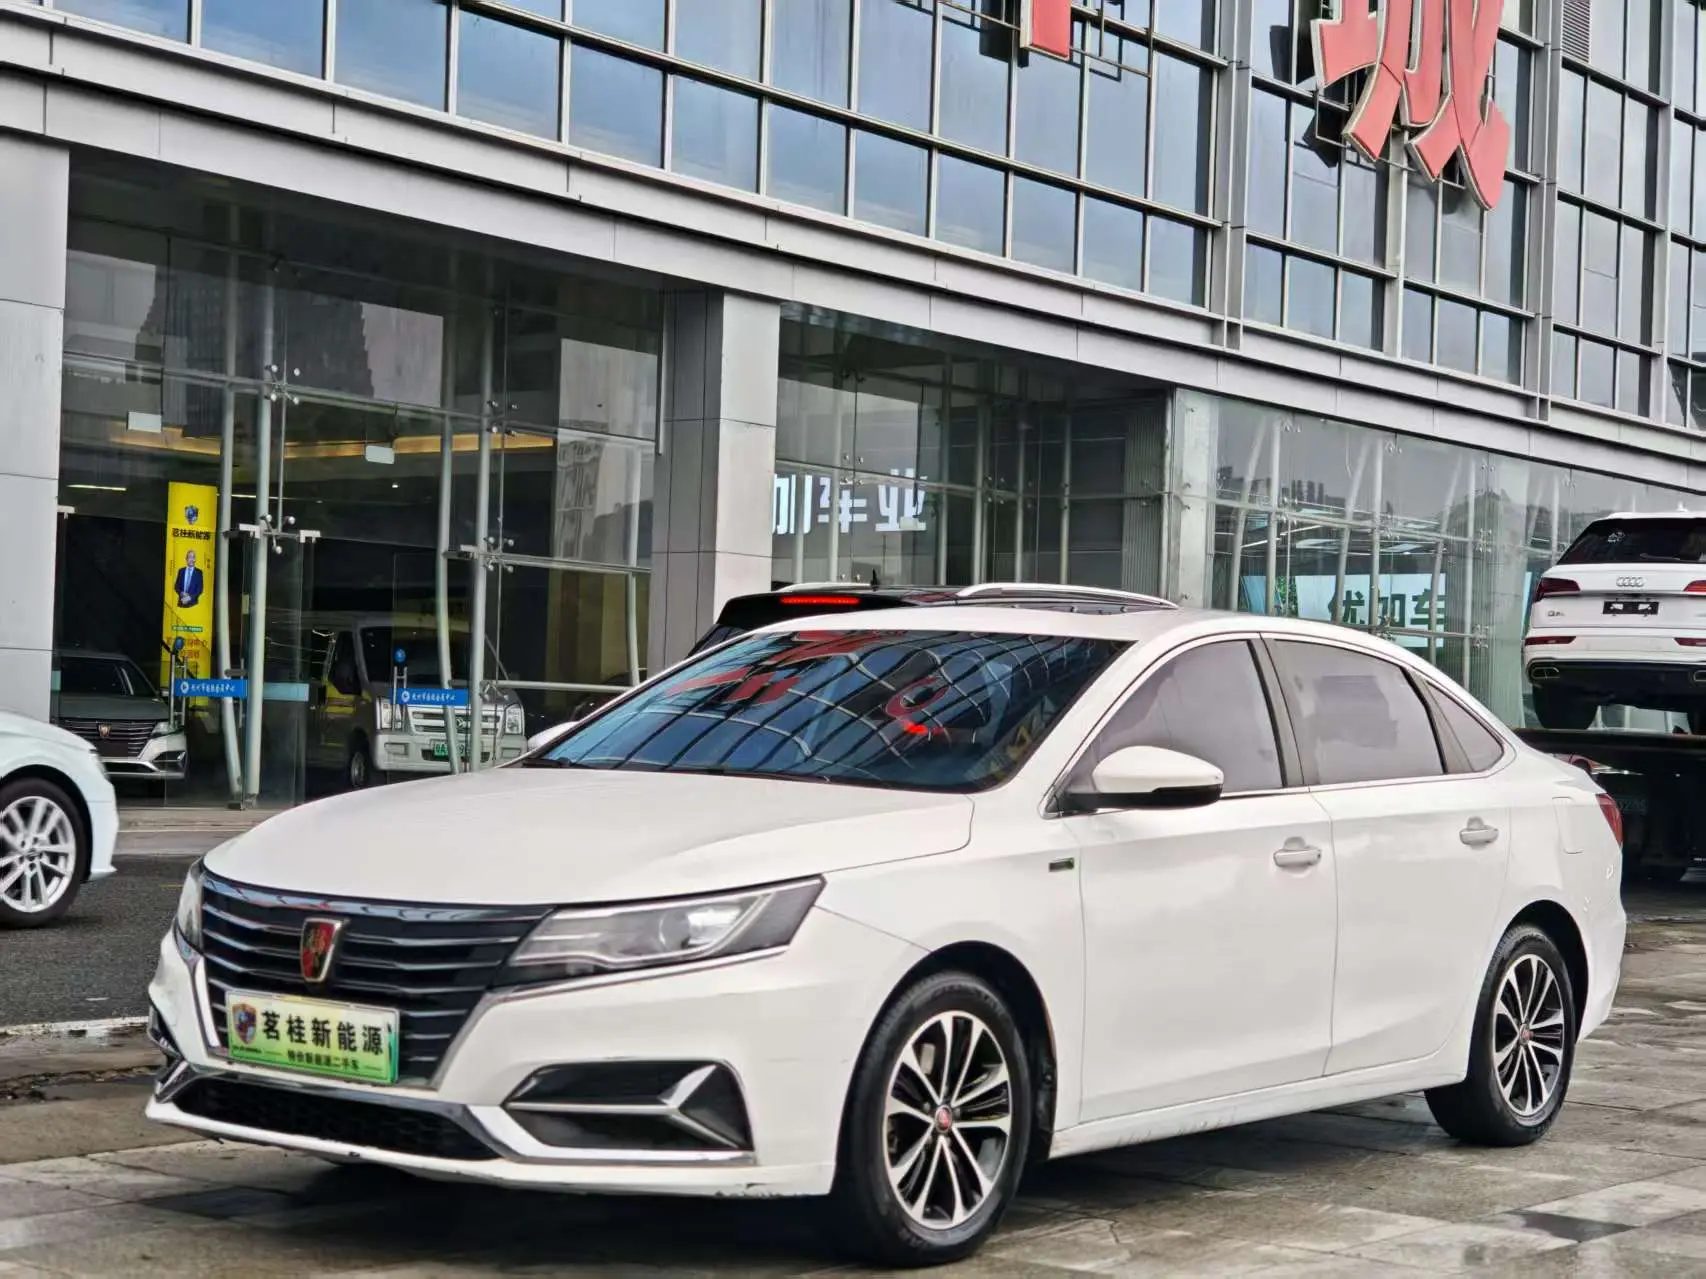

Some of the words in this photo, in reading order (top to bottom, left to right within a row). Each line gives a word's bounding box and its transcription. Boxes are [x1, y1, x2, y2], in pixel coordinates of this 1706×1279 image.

[262, 1010, 384, 1056] 茗桂新能源
